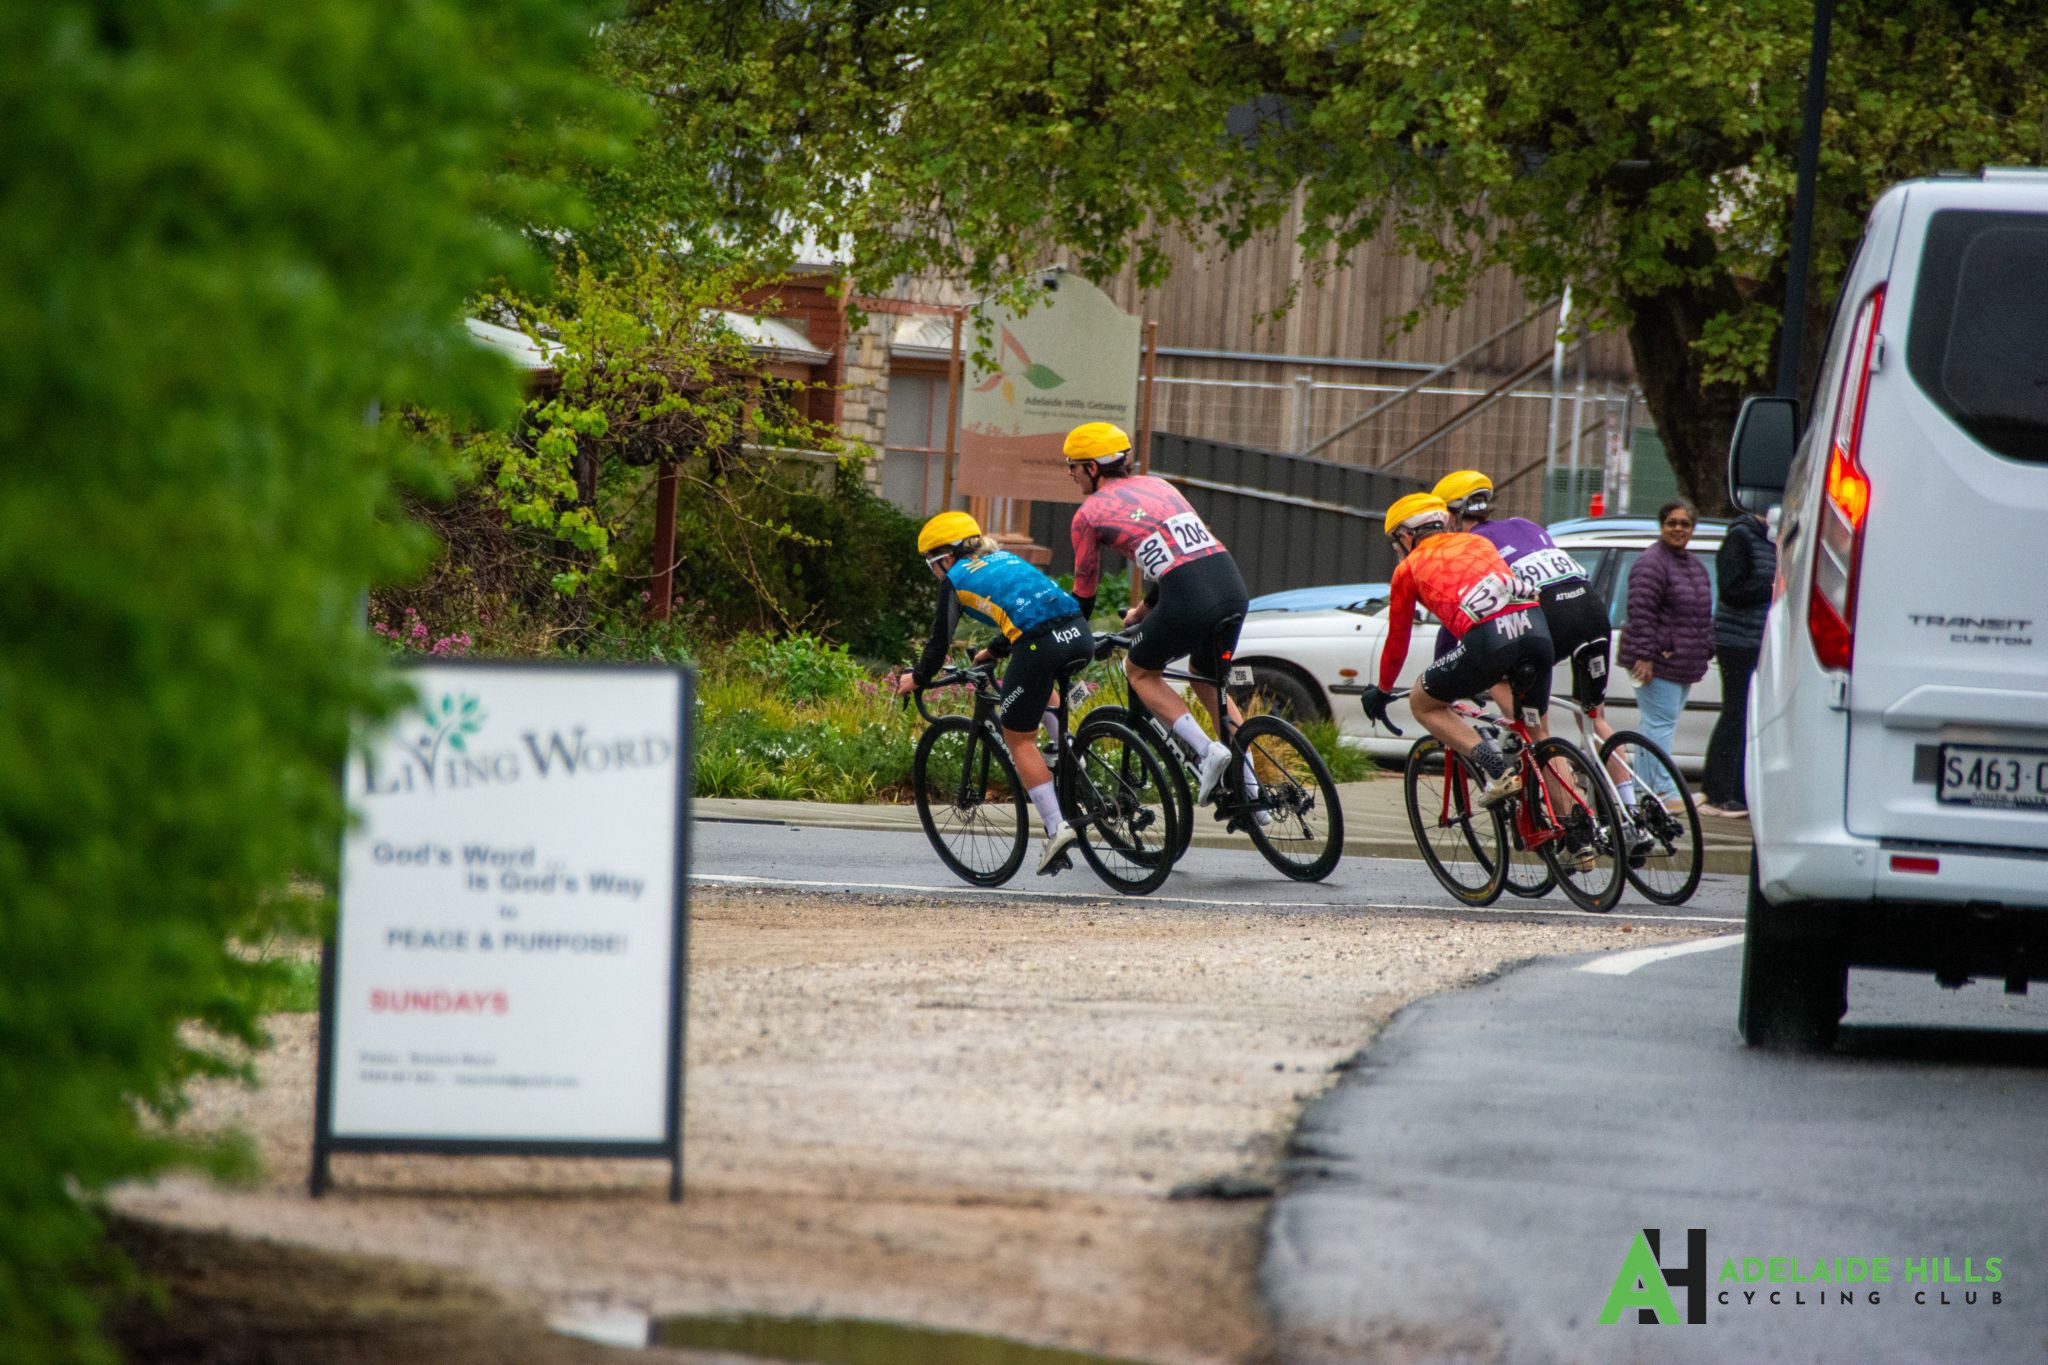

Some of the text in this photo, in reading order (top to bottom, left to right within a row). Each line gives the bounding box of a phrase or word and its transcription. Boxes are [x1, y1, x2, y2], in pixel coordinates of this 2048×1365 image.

[1025, 396, 1127, 414] Adelaide Hills Getaway
[1174, 522, 1210, 549] 206
[1138, 538, 1169, 576] 206
[1908, 613, 2033, 631] TRANSIT
[1051, 626, 1081, 645] kpa
[1951, 634, 2033, 646] CUSTOM
[523, 725, 673, 778] WORD
[373, 842, 536, 868] God's Word
[498, 872, 579, 894] God's
[589, 874, 646, 898] Way
[387, 929, 468, 952] PEACE
[502, 932, 629, 955] PURPOSE!
[369, 987, 509, 1016] SUNDAYS
